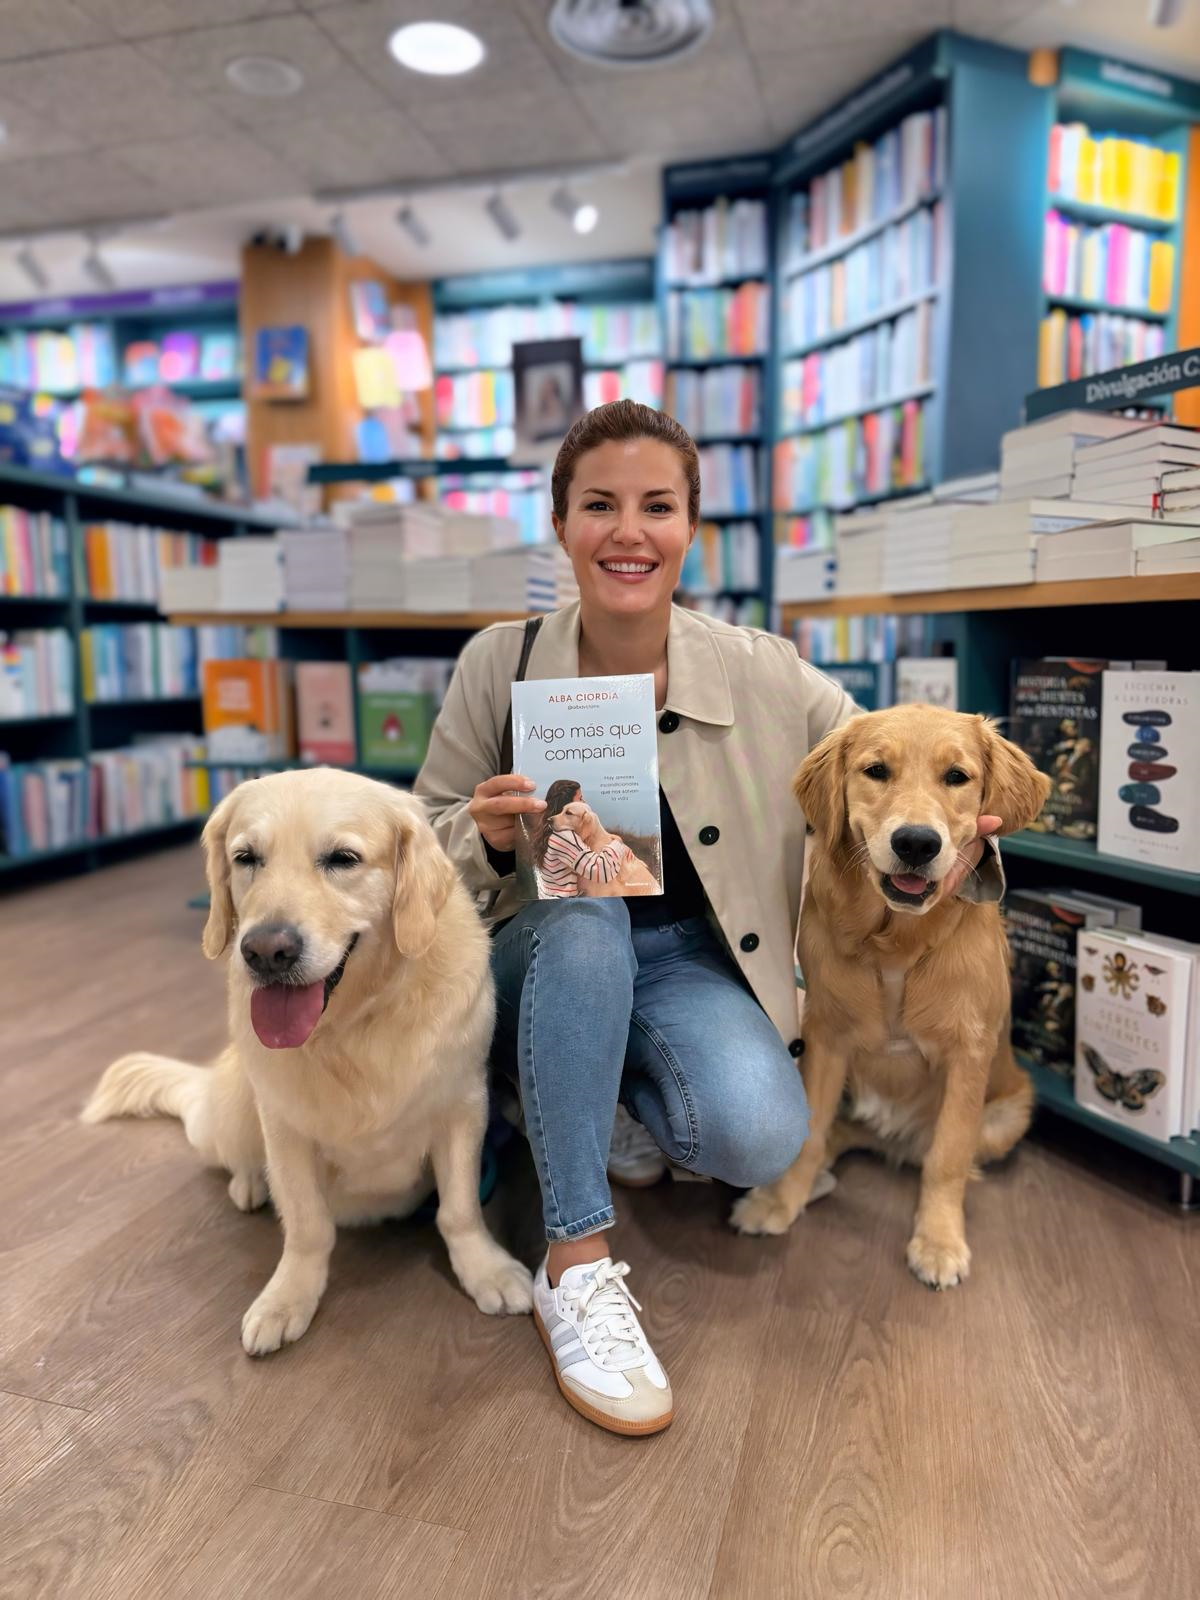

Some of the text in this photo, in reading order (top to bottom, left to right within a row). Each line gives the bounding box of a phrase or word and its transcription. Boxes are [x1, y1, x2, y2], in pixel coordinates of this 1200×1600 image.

[1086, 355, 1200, 404] Divulgación C
[548, 694, 573, 704] ALBA
[528, 722, 642, 744] Algo más que
[545, 743, 625, 763] compañía
